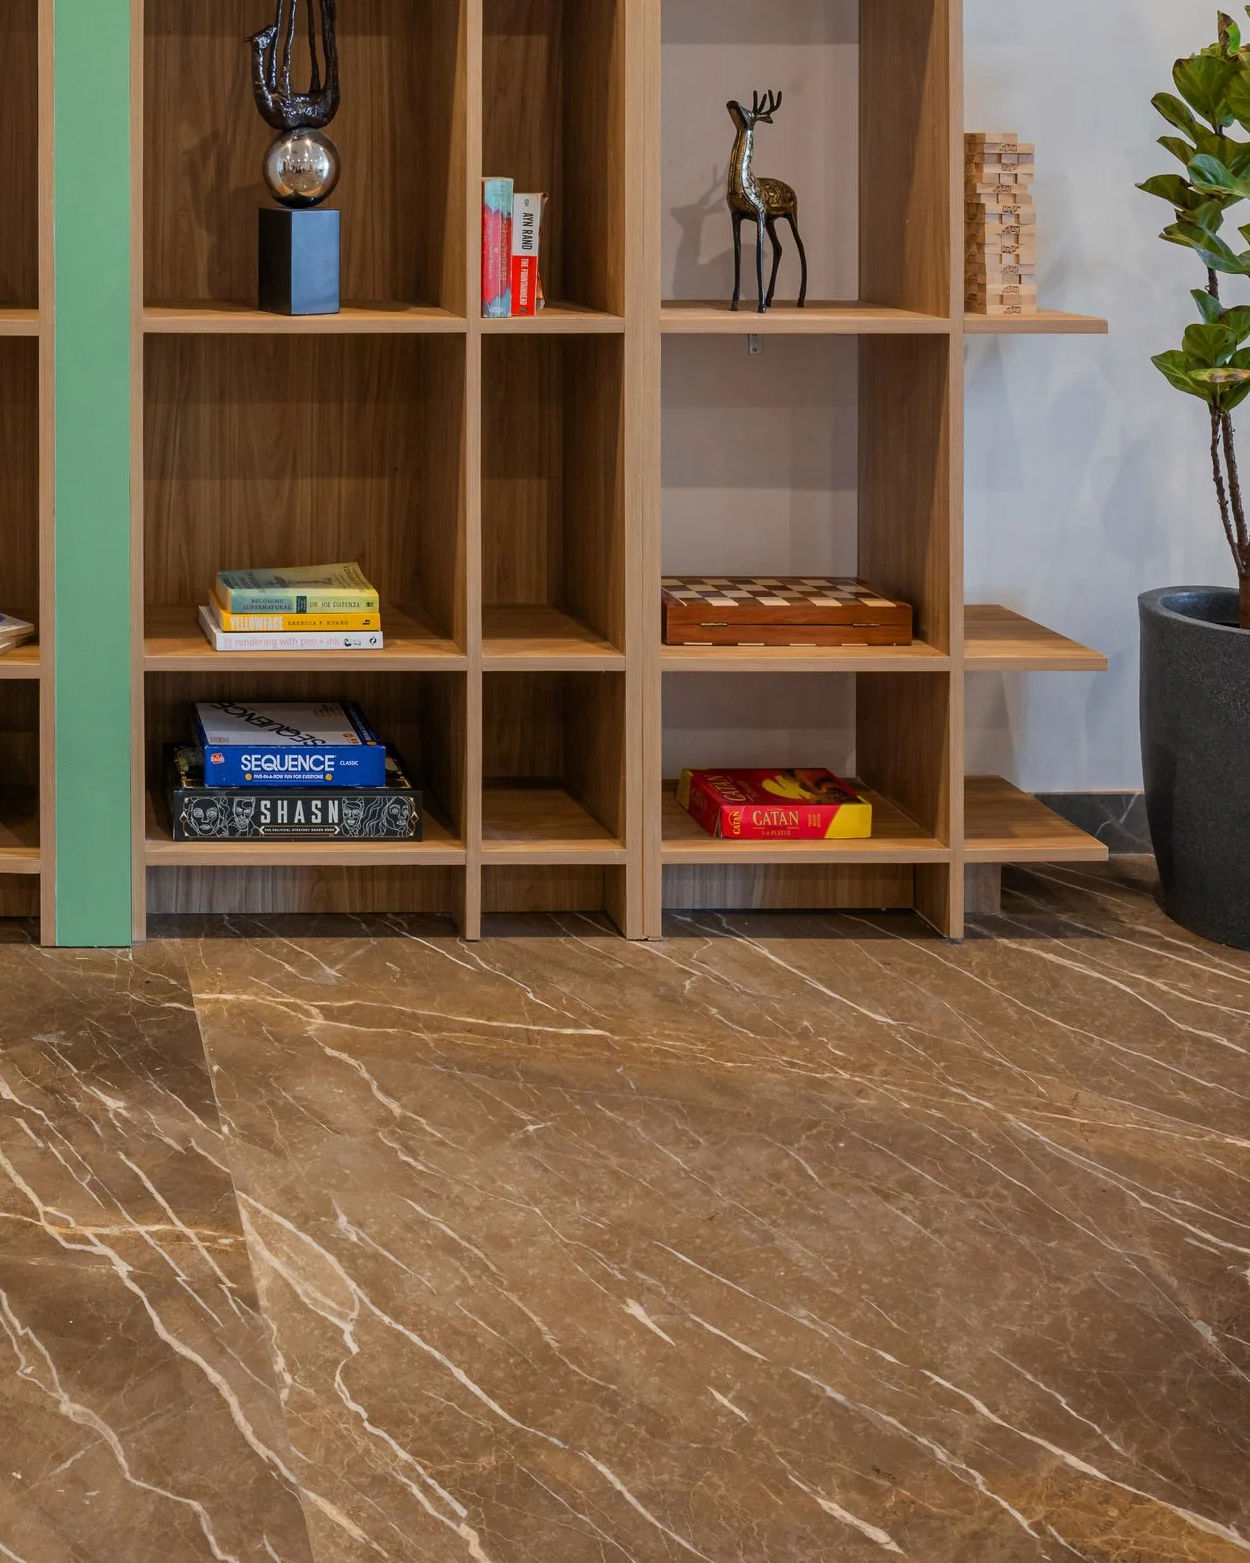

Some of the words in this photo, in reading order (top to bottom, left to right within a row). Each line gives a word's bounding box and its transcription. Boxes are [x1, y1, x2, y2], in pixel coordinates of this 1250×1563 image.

[522, 212, 534, 227] AYN
[521, 229, 533, 250] RAND
[521, 258, 529, 268] THE
[230, 616, 284, 631] YELLOWFACE
[235, 637, 277, 649] rendering
[279, 636, 298, 647] with
[300, 639, 317, 648] pen
[240, 754, 335, 771] SEQUENCE
[260, 800, 339, 824] SHASN
[752, 810, 799, 826] CATAN
[732, 811, 741, 835] CATAN
